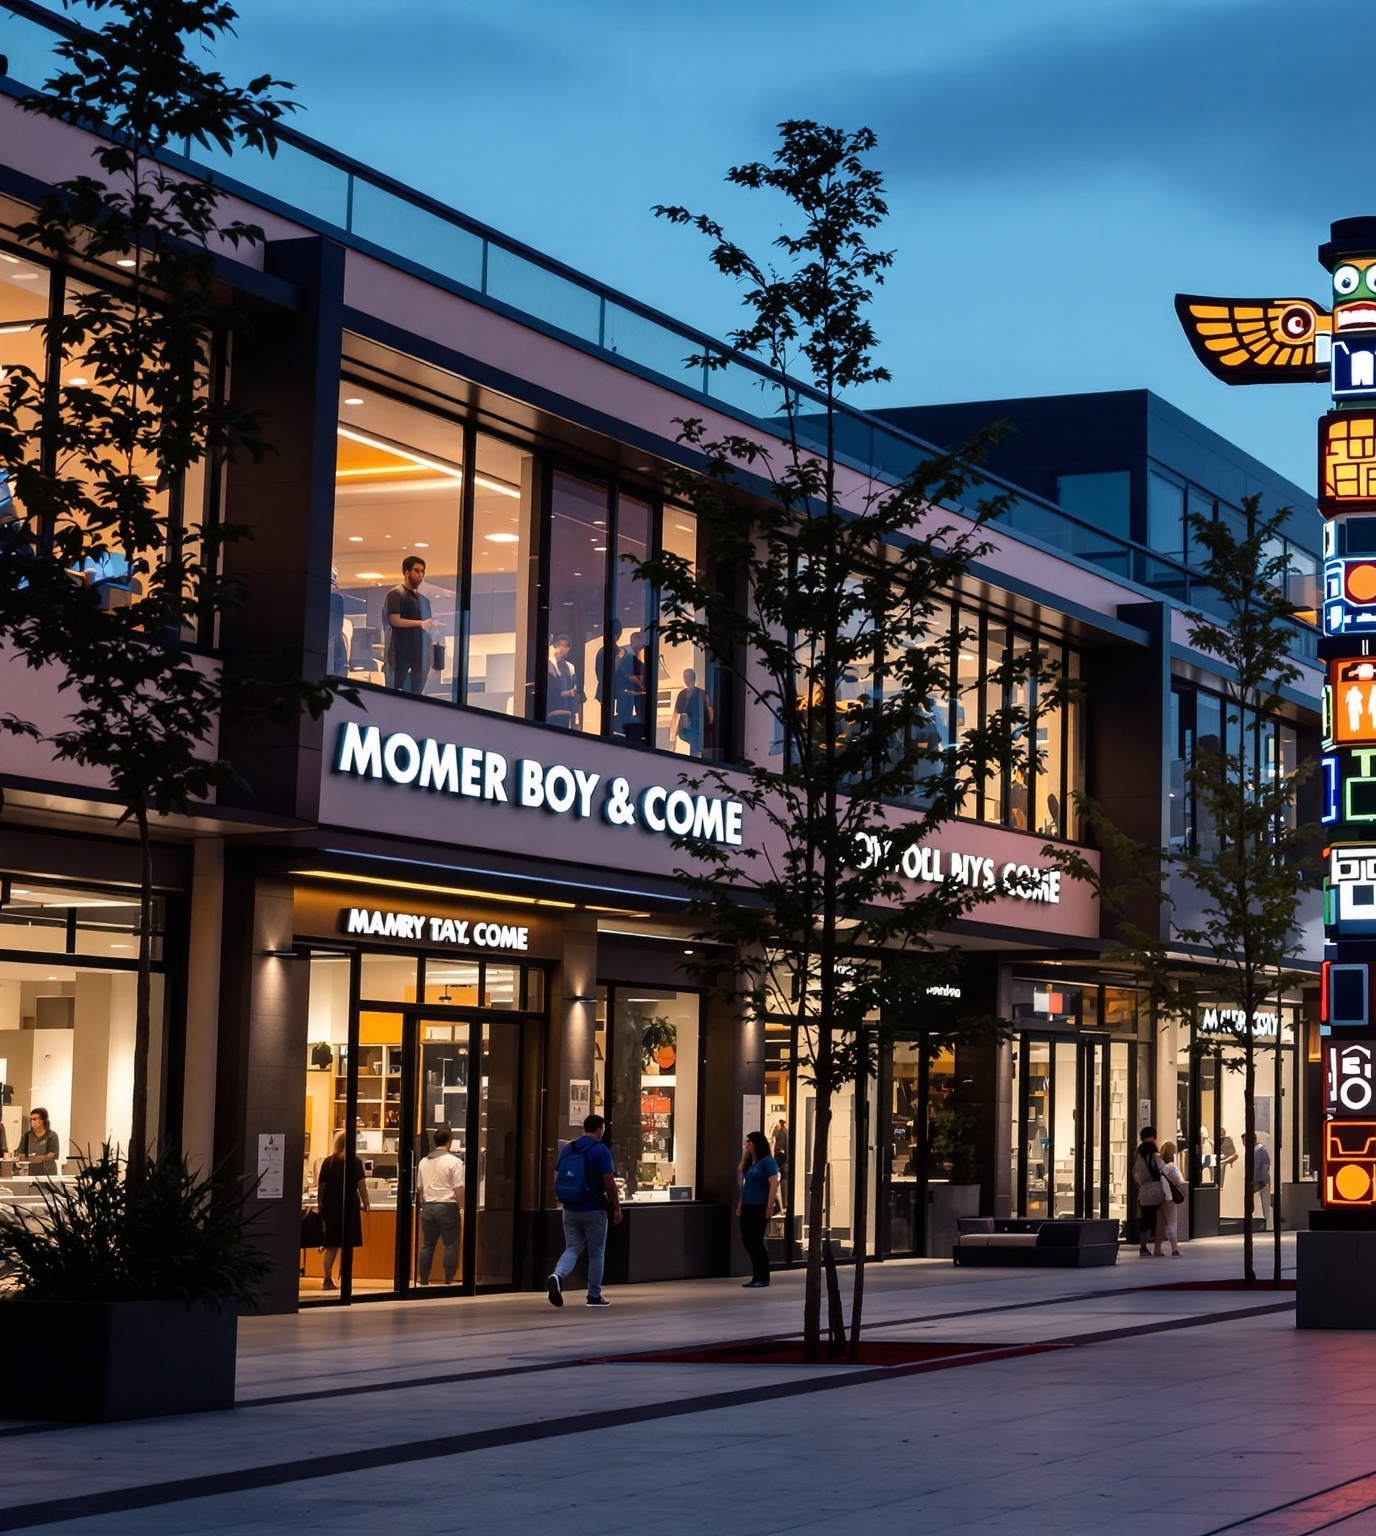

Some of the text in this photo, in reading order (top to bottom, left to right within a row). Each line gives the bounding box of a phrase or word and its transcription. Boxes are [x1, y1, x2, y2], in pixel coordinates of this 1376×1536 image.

[338, 721, 743, 846] MOMER BOY & COME
[473, 922, 529, 951] COME
